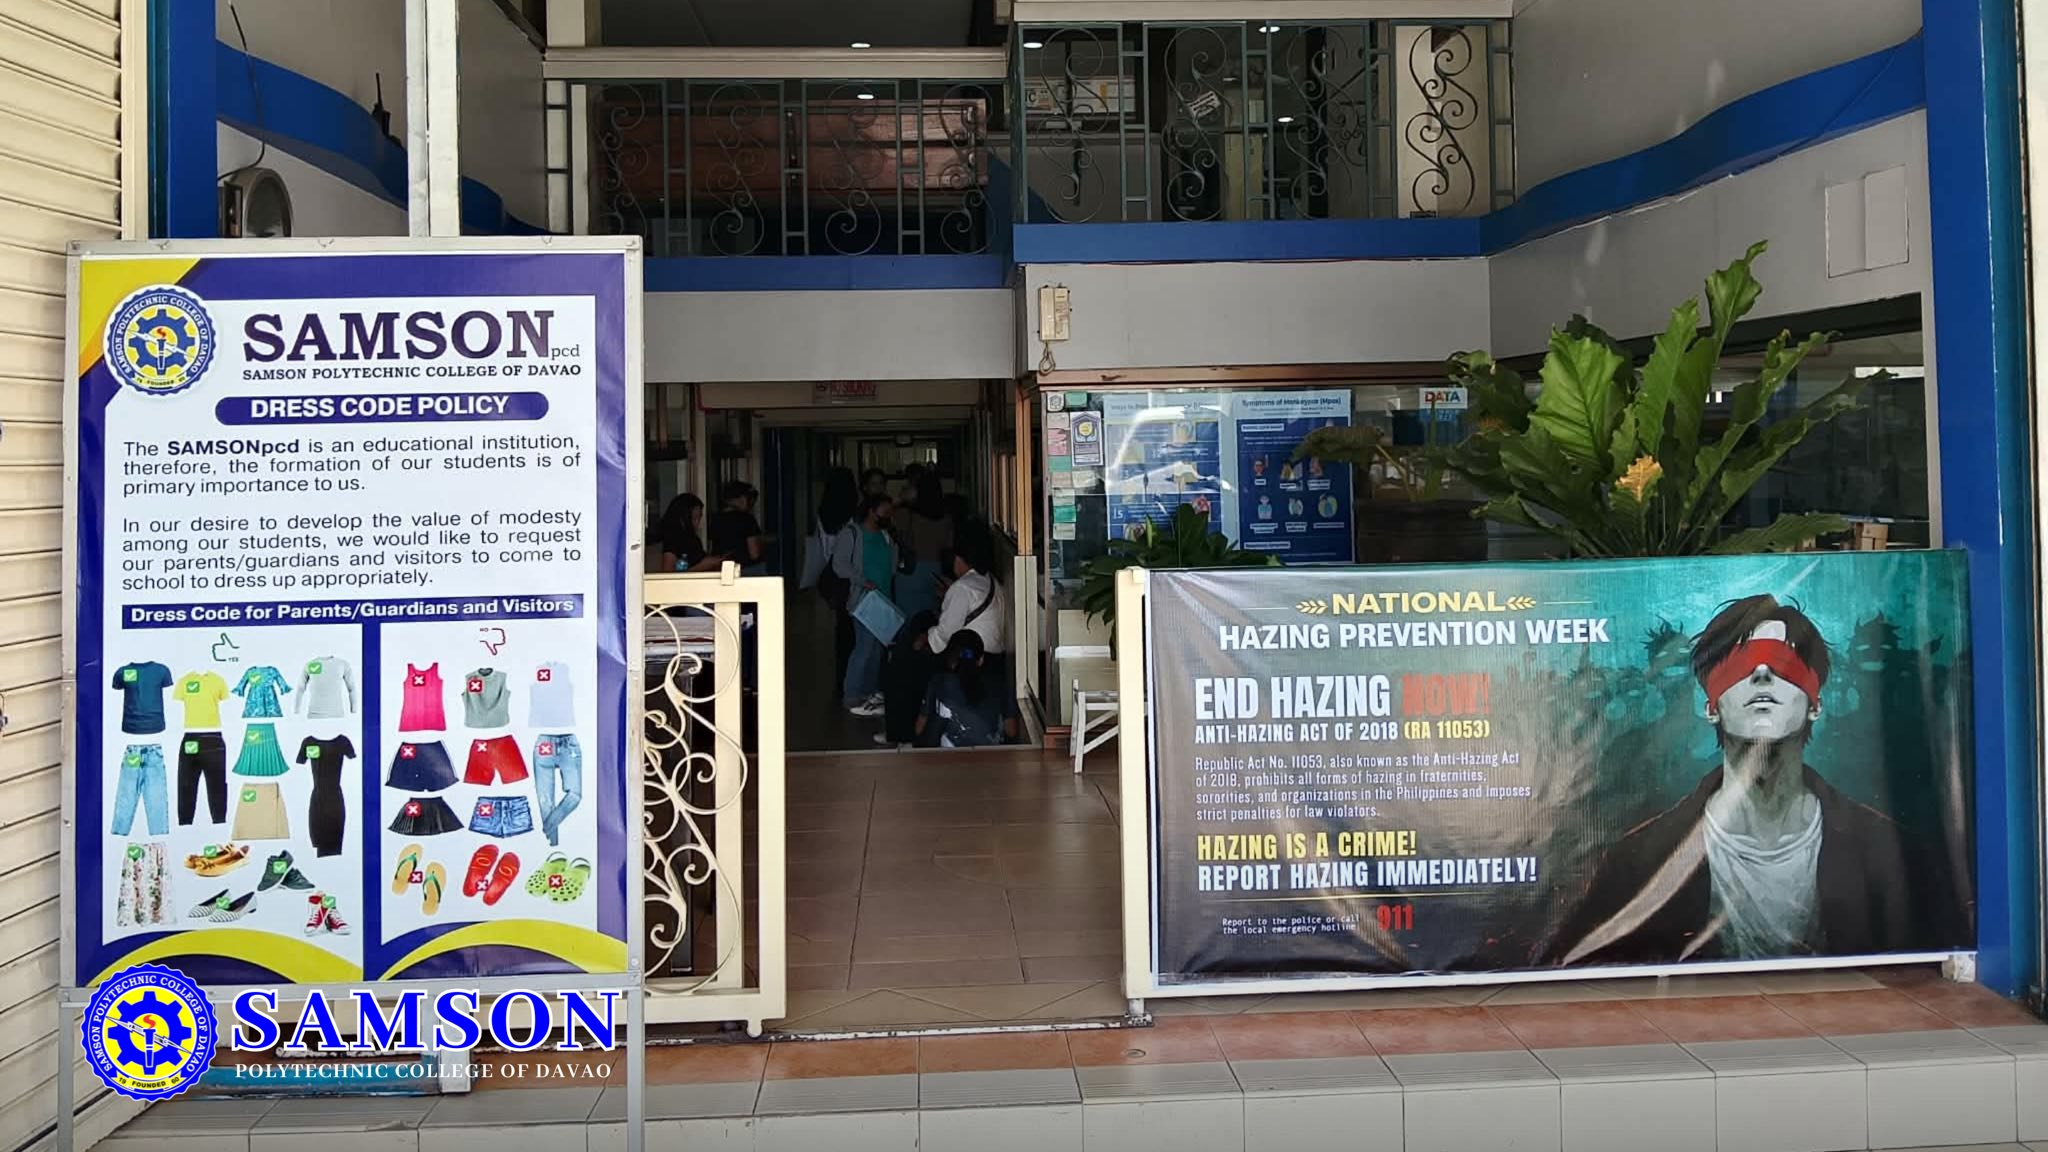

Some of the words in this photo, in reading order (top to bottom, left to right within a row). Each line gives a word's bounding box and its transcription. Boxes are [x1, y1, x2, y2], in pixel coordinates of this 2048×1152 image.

[119, 295, 168, 335] POLYTECHNIC
[170, 297, 205, 324] COLLEGE
[199, 328, 209, 340] OF
[243, 310, 554, 362] SAMSON
[551, 345, 580, 360] pcd
[115, 336, 132, 374] SAMSON
[190, 343, 209, 373] DAVAO
[242, 367, 307, 381] SAMSON
[311, 365, 421, 379] POLYTECHNIC
[424, 364, 498, 377] COLLEGE
[501, 364, 523, 376] OF
[526, 363, 581, 376] DAVAO
[250, 397, 335, 418] DRESS
[339, 396, 412, 417] CODE
[417, 394, 509, 415] POLICY
[1424, 390, 1462, 403] DATA
[122, 440, 159, 456] The
[166, 438, 300, 456] SAMSONpcd
[308, 437, 324, 453] is
[330, 440, 354, 453] an
[362, 435, 473, 452] educational
[481, 433, 580, 450] institution,
[123, 459, 217, 475] therefore,
[228, 458, 259, 473] the
[269, 456, 361, 473] formation
[370, 454, 391, 471] of
[400, 457, 433, 470] our
[442, 453, 526, 470] students
[536, 452, 552, 468] is
[561, 451, 581, 467] of
[122, 479, 196, 498] primary
[200, 478, 309, 495] importance
[313, 476, 333, 491] to
[337, 477, 365, 491] us.
[122, 517, 140, 533] In
[148, 519, 181, 533] our
[189, 515, 249, 532] desire
[258, 515, 277, 530] to
[286, 513, 363, 530] develop
[371, 512, 402, 528] the
[410, 511, 461, 527] value
[469, 509, 489, 526] of
[498, 509, 582, 526] modesty
[121, 538, 188, 554] among
[197, 537, 230, 551] our
[238, 533, 327, 550] students,
[335, 534, 364, 547] we
[371, 530, 429, 546] would
[438, 529, 471, 545] like
[479, 529, 499, 544] to
[507, 527, 581, 545] request
[121, 558, 154, 572] our
[163, 551, 340, 572] parents/guardians
[348, 550, 385, 566] and
[393, 549, 462, 565] visitors
[470, 548, 490, 564] to
[498, 549, 553, 563] come
[562, 546, 581, 561] to
[122, 574, 184, 590] school
[189, 574, 209, 589] to
[213, 572, 267, 588] dress
[271, 573, 296, 590] up
[300, 568, 433, 589] appropriately.
[130, 607, 187, 622] Dress
[189, 605, 241, 621] Code
[243, 604, 273, 620] for
[276, 601, 458, 619] Parents/Guardians
[461, 598, 498, 614] and
[501, 597, 573, 613] Visitors
[1331, 591, 1506, 614] NATIONAL
[1218, 623, 1330, 649] HAZING
[1338, 620, 1516, 647] PREVENTION
[1524, 618, 1610, 644] WEEK
[1194, 677, 1259, 719] END
[1270, 674, 1391, 718] HAZING
[1402, 672, 1491, 715] NOW!
[1194, 723, 1294, 743] ANTI-HAZING
[1299, 722, 1329, 742] ACT
[1333, 721, 1353, 741] OF
[1358, 721, 1398, 741] 2018
[1403, 720, 1431, 739] (RA
[1436, 719, 1490, 738] 11053)
[1194, 755, 1244, 773] Republic
[1246, 755, 1265, 770] Act
[1268, 754, 1288, 769] No.
[1329, 753, 1353, 768] also
[1355, 753, 1392, 767] known
[1394, 755, 1409, 767] as
[1411, 752, 1430, 766] the
[1432, 751, 1498, 767] Anti-Hazing
[1500, 749, 1519, 764] Act
[1195, 773, 1207, 788] of
[1243, 771, 1295, 789] prohibits
[1297, 770, 1312, 785] all
[1315, 771, 1348, 785] forms
[1350, 769, 1362, 784] of
[1365, 769, 1403, 786] hazing
[1405, 769, 1416, 783] in
[1195, 790, 1254, 805] sororities,
[1257, 787, 1278, 803] and
[1280, 787, 1358, 804] organizations
[1360, 786, 1371, 801] in
[1374, 785, 1393, 800] the
[1395, 785, 1459, 802] Philippines
[1461, 784, 1482, 798] and
[1485, 785, 1531, 800] imposes
[1195, 806, 1227, 821] strict
[1230, 805, 1282, 822] penalties
[1284, 804, 1301, 818] for
[1303, 804, 1324, 818] law
[1326, 803, 1380, 818] violators.
[1197, 834, 1277, 860] HAZING
[1285, 832, 1307, 858] IS
[1314, 831, 1329, 857] A
[1337, 830, 1416, 856] CRIME!
[1198, 863, 1281, 891] REPORT
[1289, 860, 1368, 888] HAZING
[1376, 856, 1537, 885] IMMEDIATELY!
[1222, 918, 1252, 927] Report
[1257, 918, 1268, 926] to
[1272, 917, 1287, 926] the
[1291, 916, 1321, 926] police
[1340, 914, 1360, 923] call
[1376, 903, 1414, 930] 911
[1222, 926, 1238, 935] the
[1243, 925, 1268, 934] local
[1272, 925, 1317, 934] emergency
